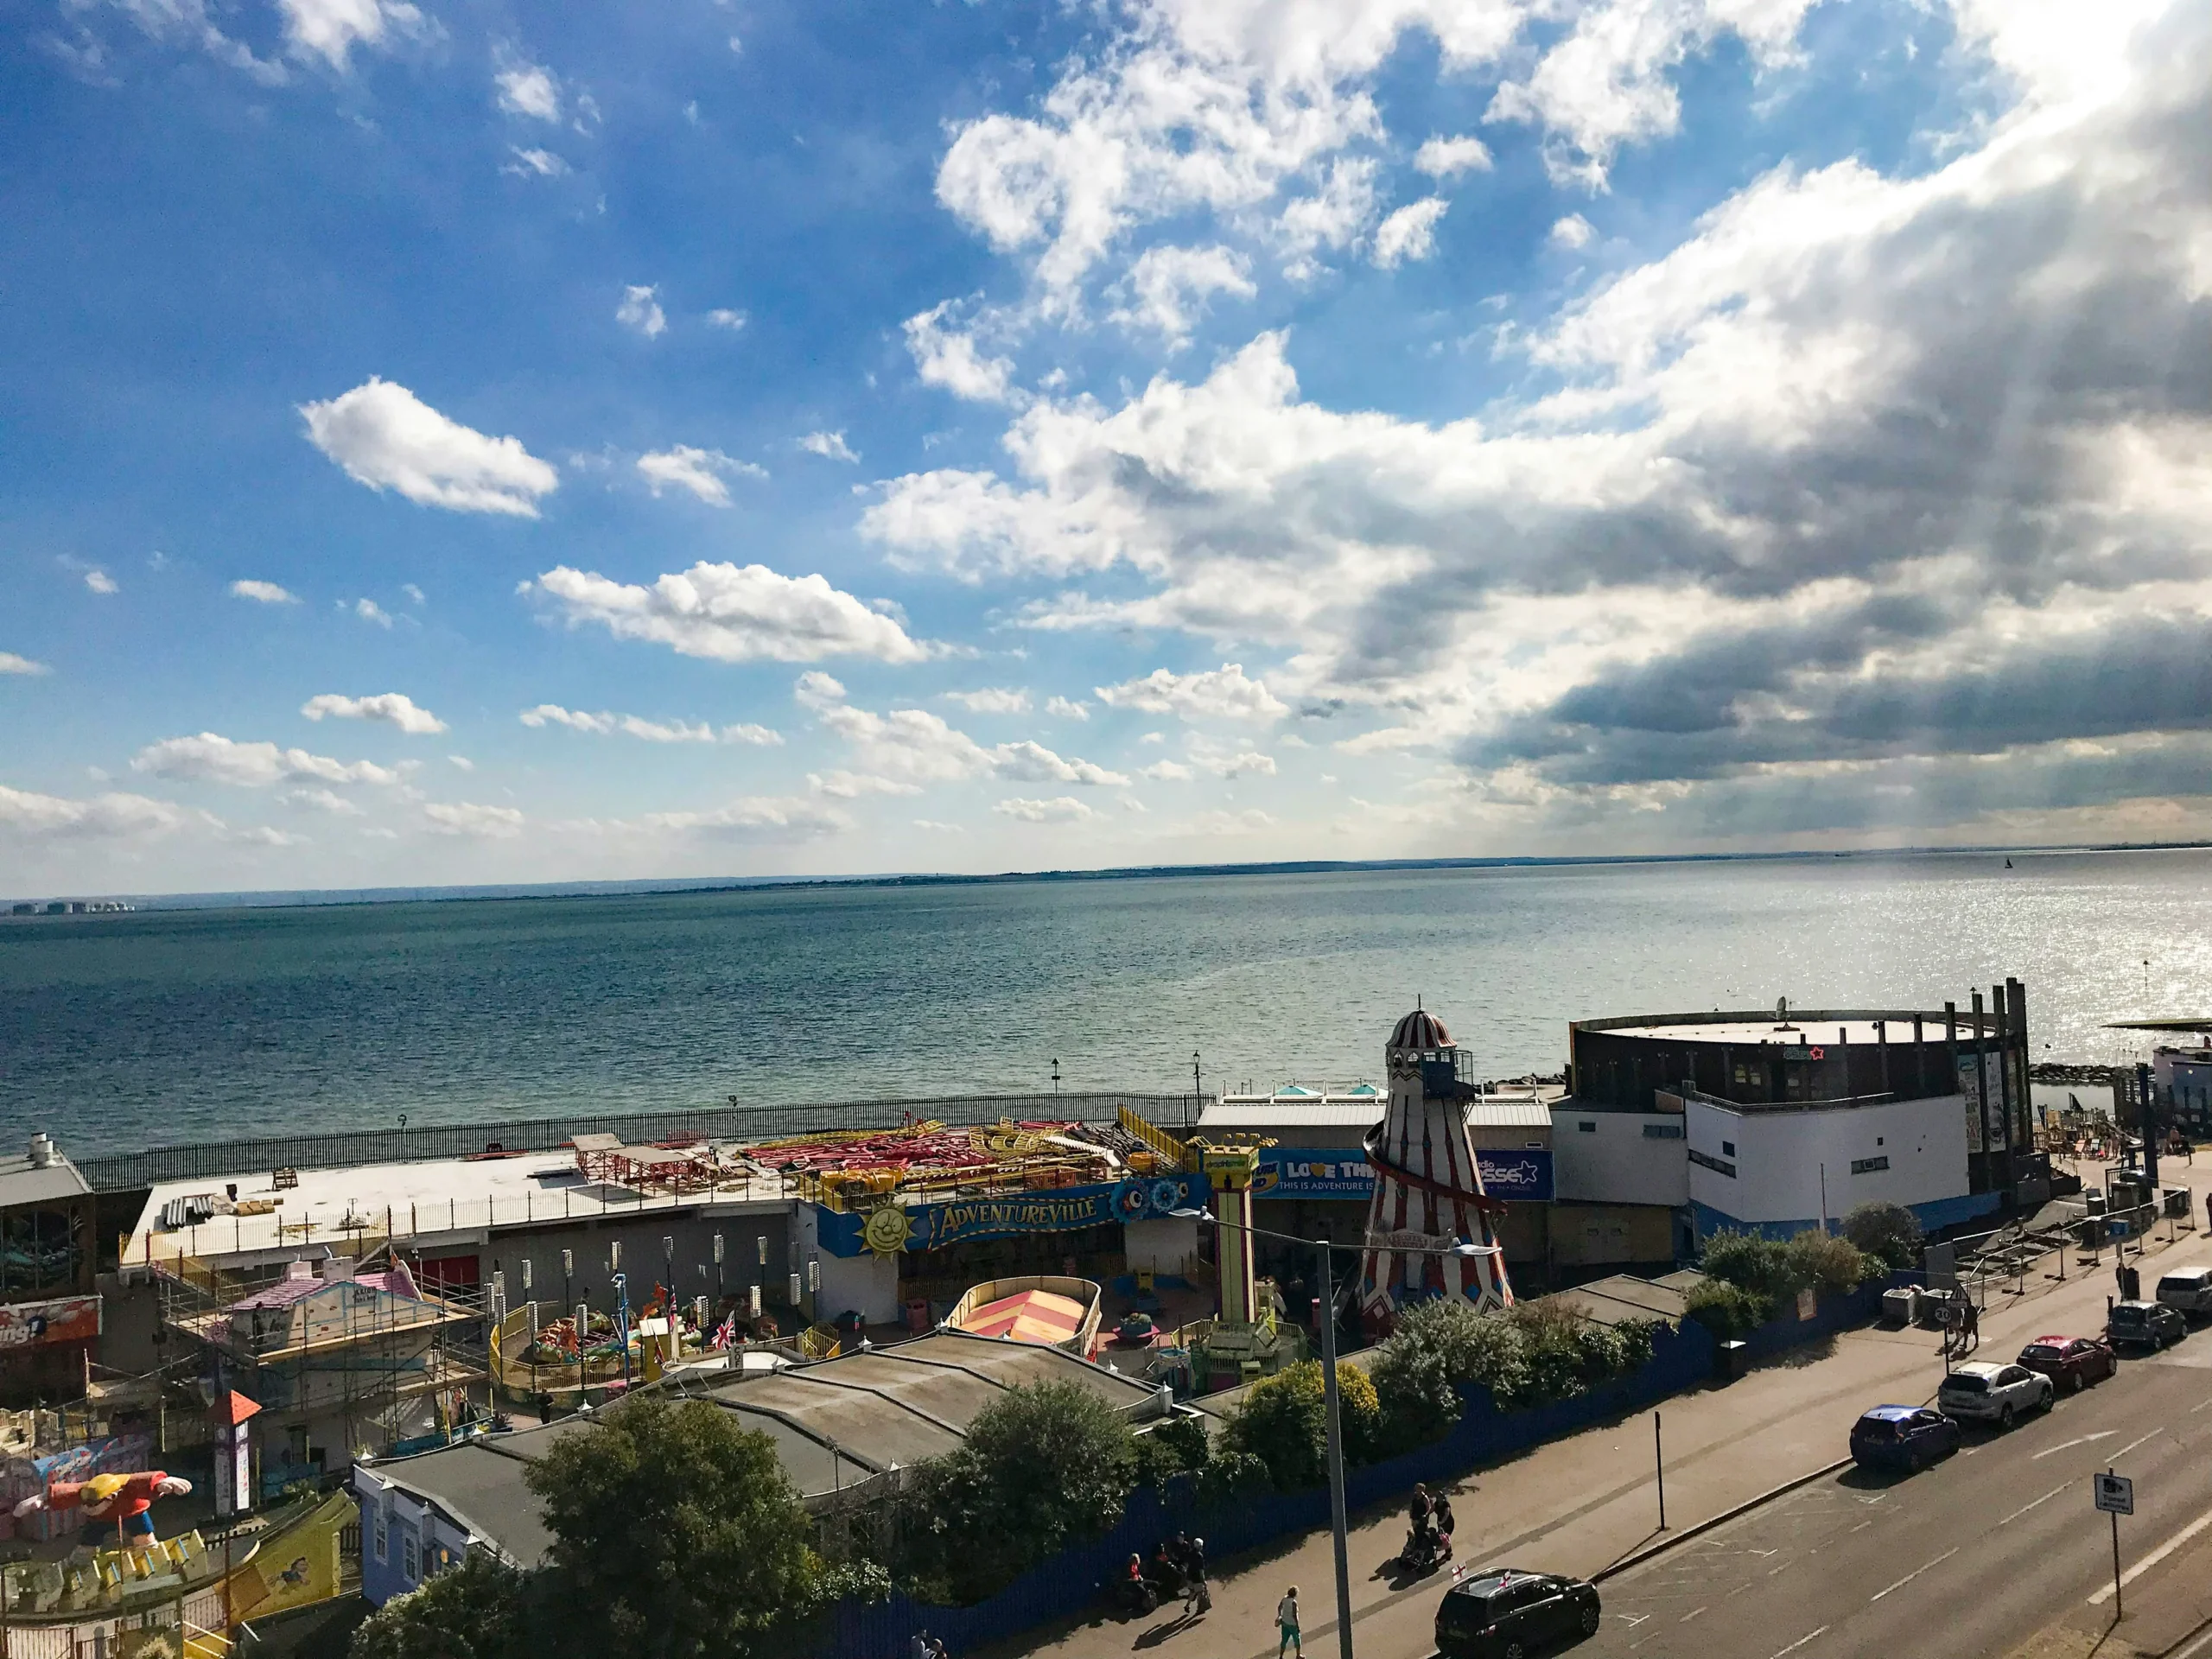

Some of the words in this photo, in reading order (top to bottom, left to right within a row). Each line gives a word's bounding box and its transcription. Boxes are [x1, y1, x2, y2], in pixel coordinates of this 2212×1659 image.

[1280, 1181, 1299, 1190] THIS
[1300, 1181, 1309, 1190] IS
[1311, 1181, 1363, 1190] ADVENTURE
[939, 1199, 1097, 1239] ADVENTUREVILLE
[1936, 1310, 1950, 1319] 30
